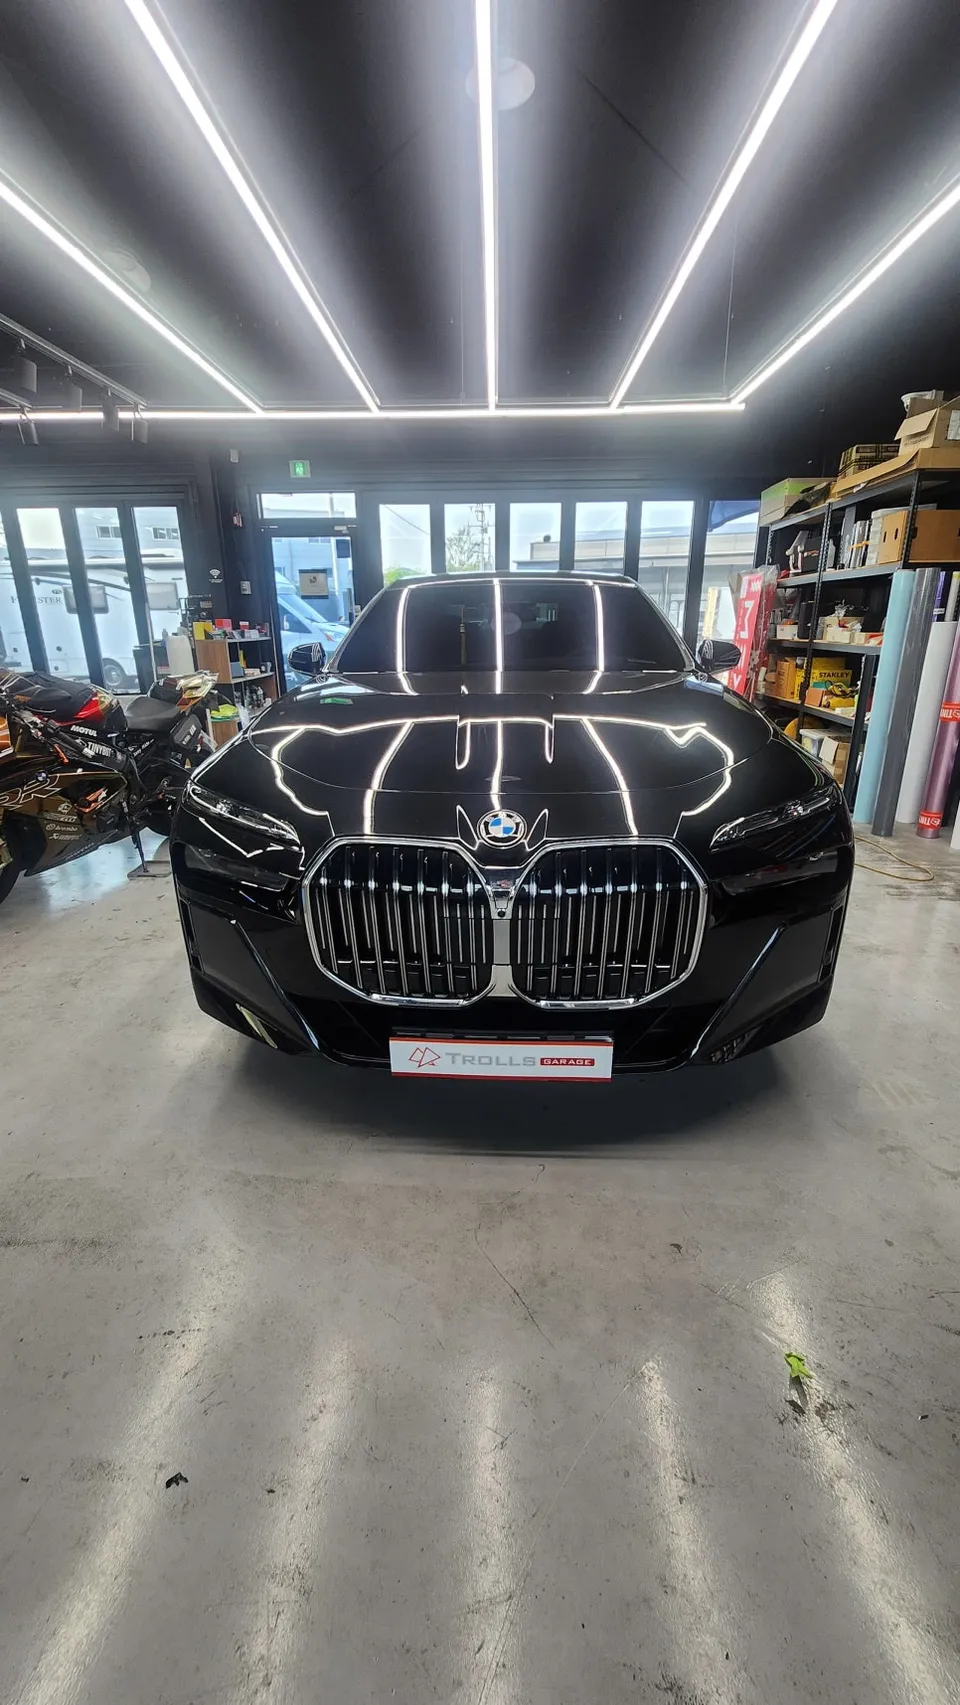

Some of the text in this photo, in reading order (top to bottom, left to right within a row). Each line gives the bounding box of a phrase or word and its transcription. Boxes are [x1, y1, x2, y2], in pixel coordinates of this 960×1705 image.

[818, 671, 850, 679] STANLEY
[70, 725, 97, 737] MOTUL
[445, 1052, 592, 1067] TROLLS GARAGE
